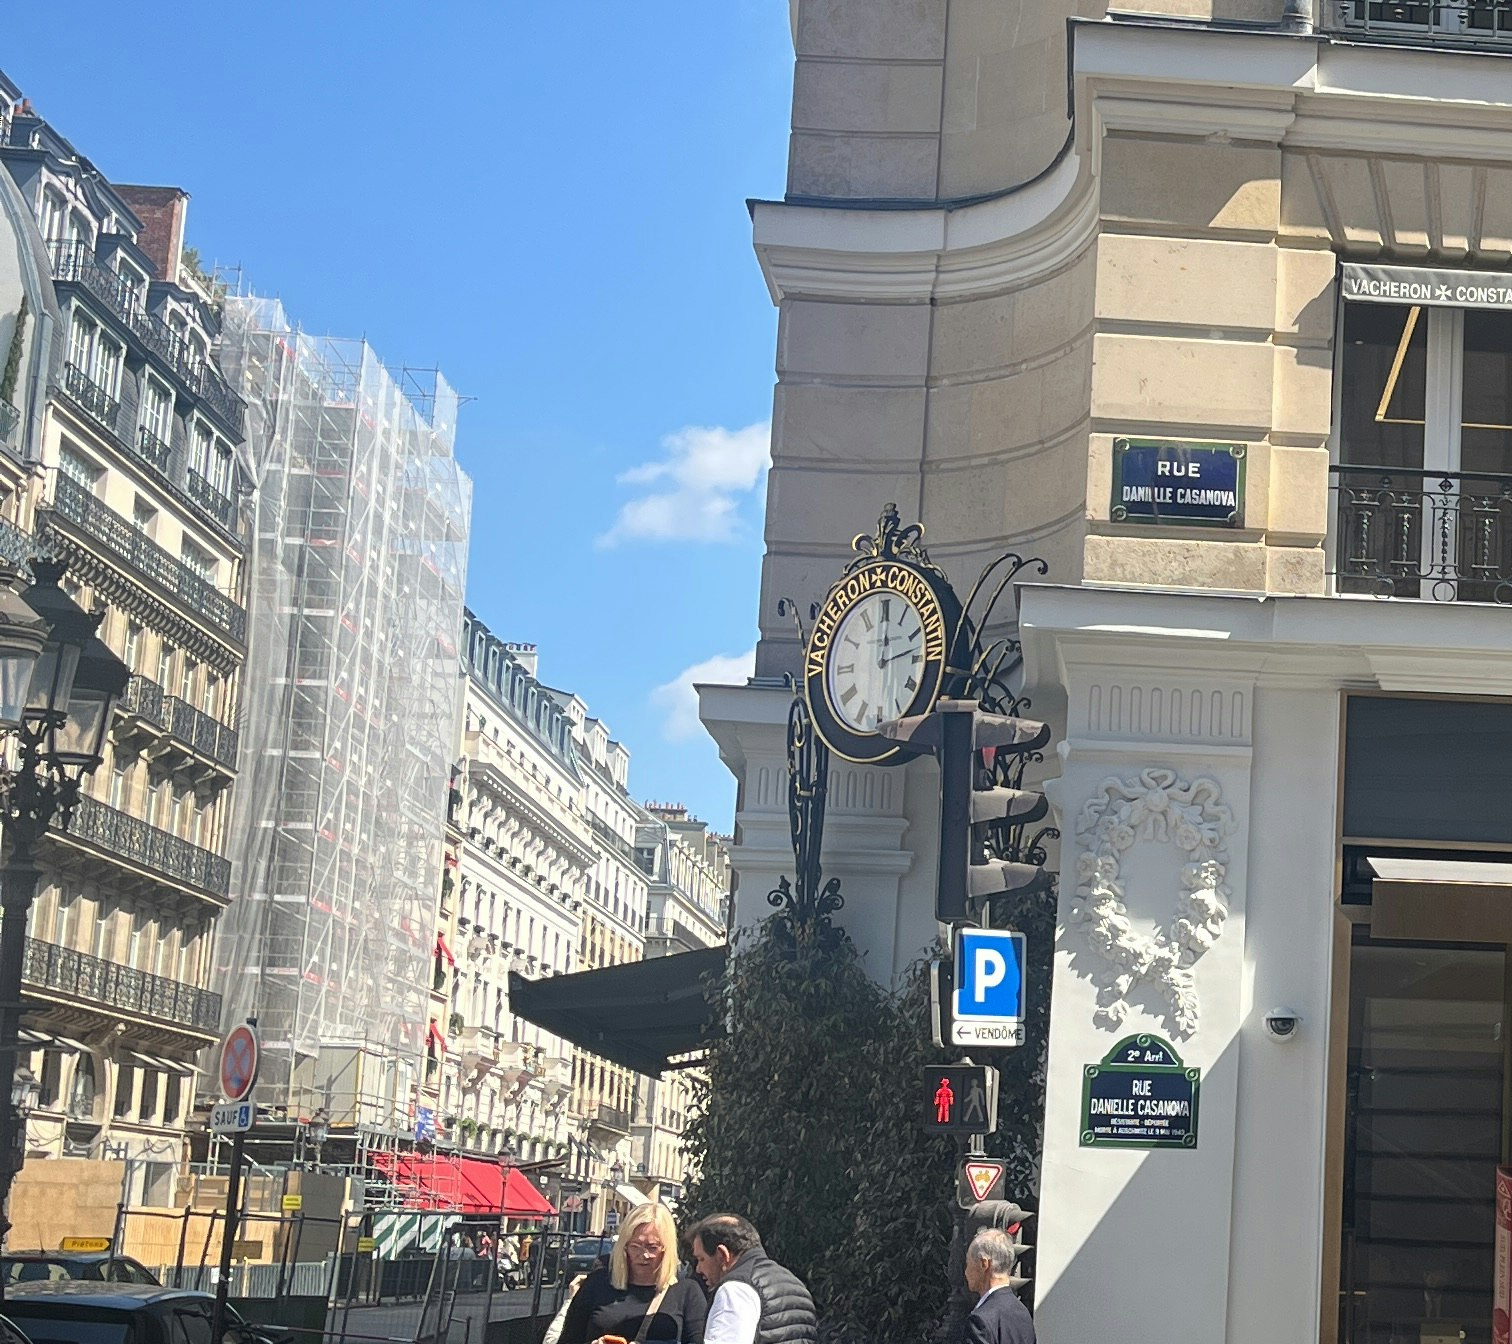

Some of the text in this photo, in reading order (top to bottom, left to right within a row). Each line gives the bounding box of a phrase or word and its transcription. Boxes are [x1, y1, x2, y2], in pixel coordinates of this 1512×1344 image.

[1350, 278, 1431, 300] VACHERON
[1157, 460, 1201, 478] RUE
[1176, 488, 1236, 507] CASANOVA
[807, 566, 943, 677] VACHERON CONSTANTIN
[974, 947, 1007, 1003] P
[974, 1025, 1024, 1041] VENDÔME
[1132, 1079, 1153, 1096] RUE
[1090, 1098, 1190, 1117] DANIELLE CASANOVA
[214, 1110, 238, 1126] SAUF
